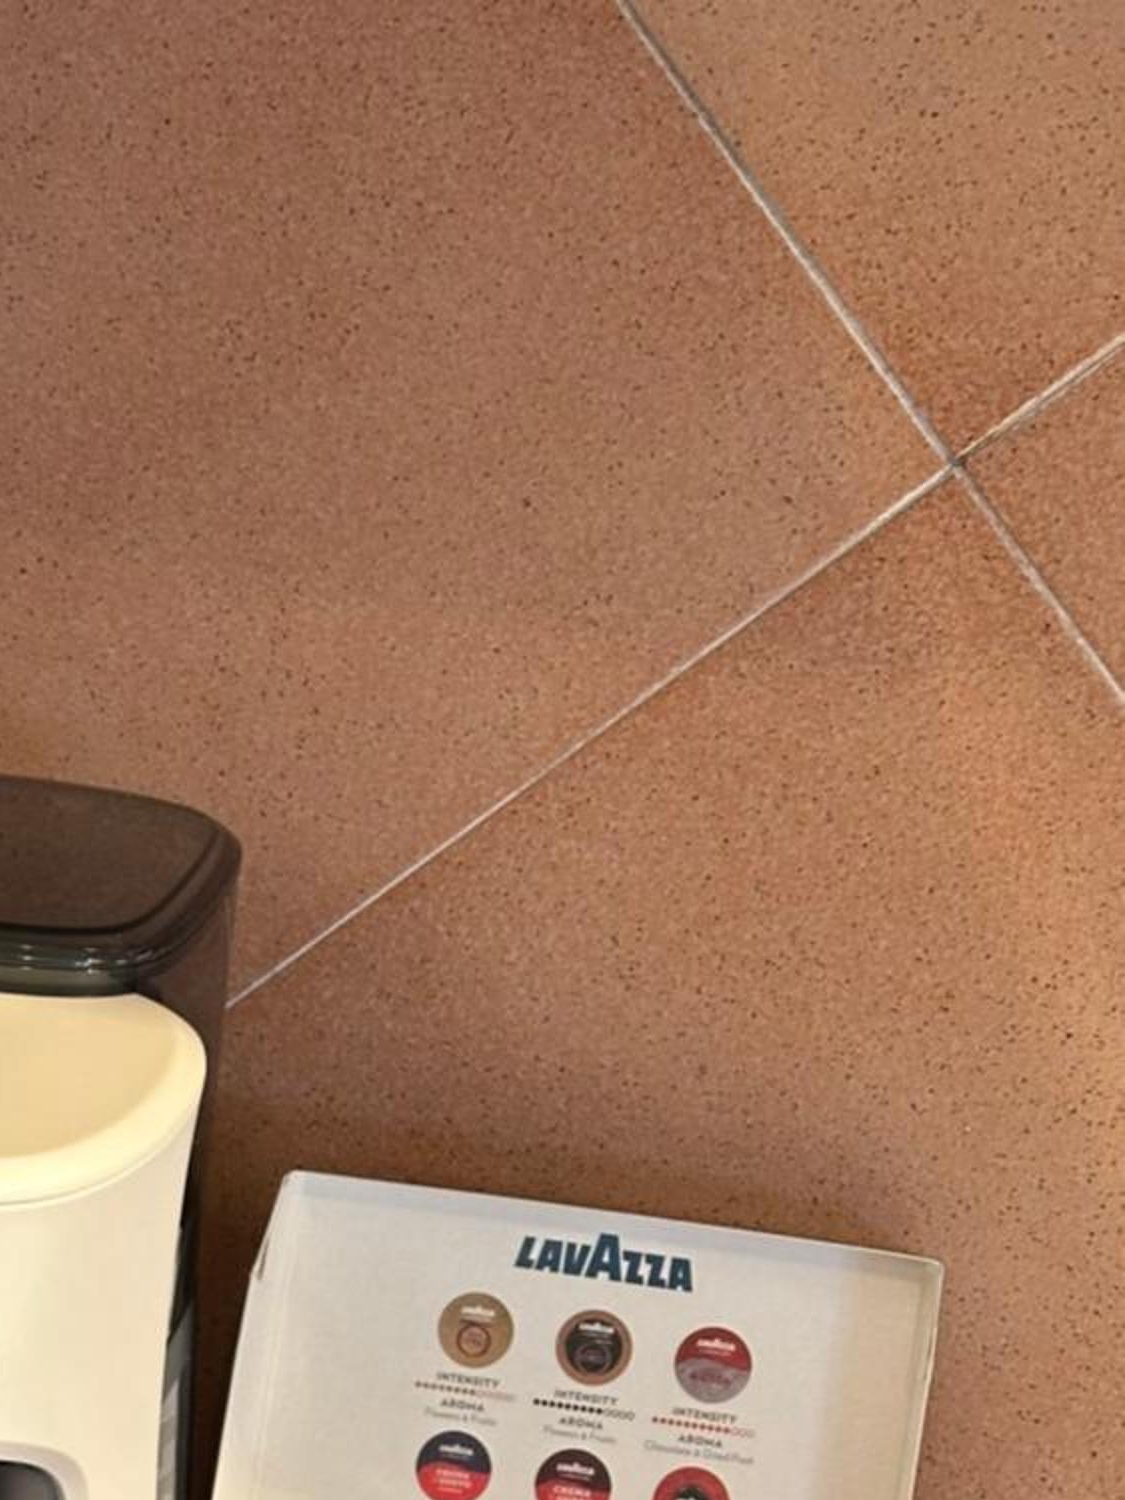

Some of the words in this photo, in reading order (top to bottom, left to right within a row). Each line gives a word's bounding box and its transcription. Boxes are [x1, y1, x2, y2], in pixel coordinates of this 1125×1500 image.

[514, 1233, 693, 1293] LAVAZZA
[436, 1372, 499, 1388] INTENSITY
[441, 1398, 484, 1412] AROMA
[554, 1389, 618, 1406] INTENSITY
[560, 1417, 603, 1430] AROMA
[672, 1407, 736, 1424] INTENSITY
[678, 1435, 722, 1448] AROMA
